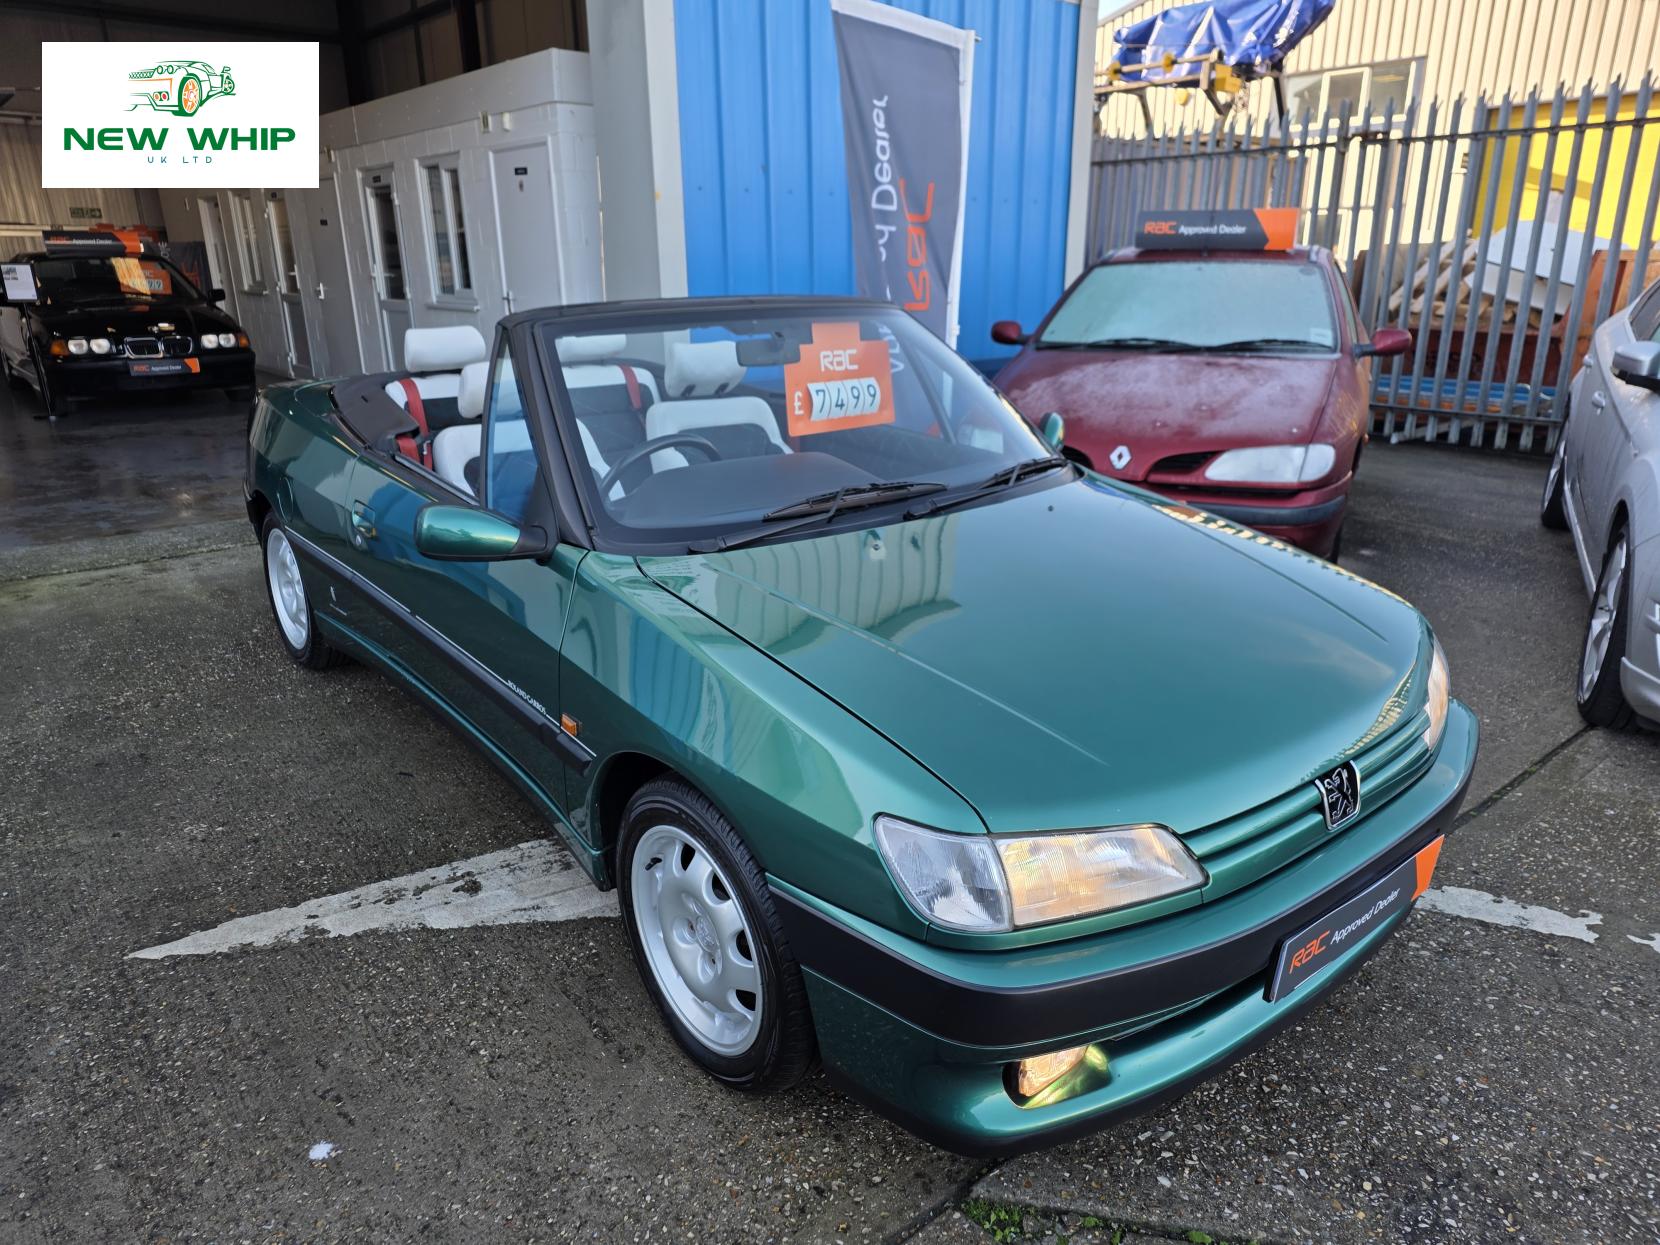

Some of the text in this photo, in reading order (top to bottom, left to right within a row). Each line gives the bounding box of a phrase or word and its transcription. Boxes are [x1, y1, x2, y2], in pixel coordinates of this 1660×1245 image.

[1178, 224, 1217, 235] Approved
[1218, 224, 1247, 234] Dealer
[1330, 906, 1375, 944] Approved
[1373, 888, 1400, 915] Dealer
